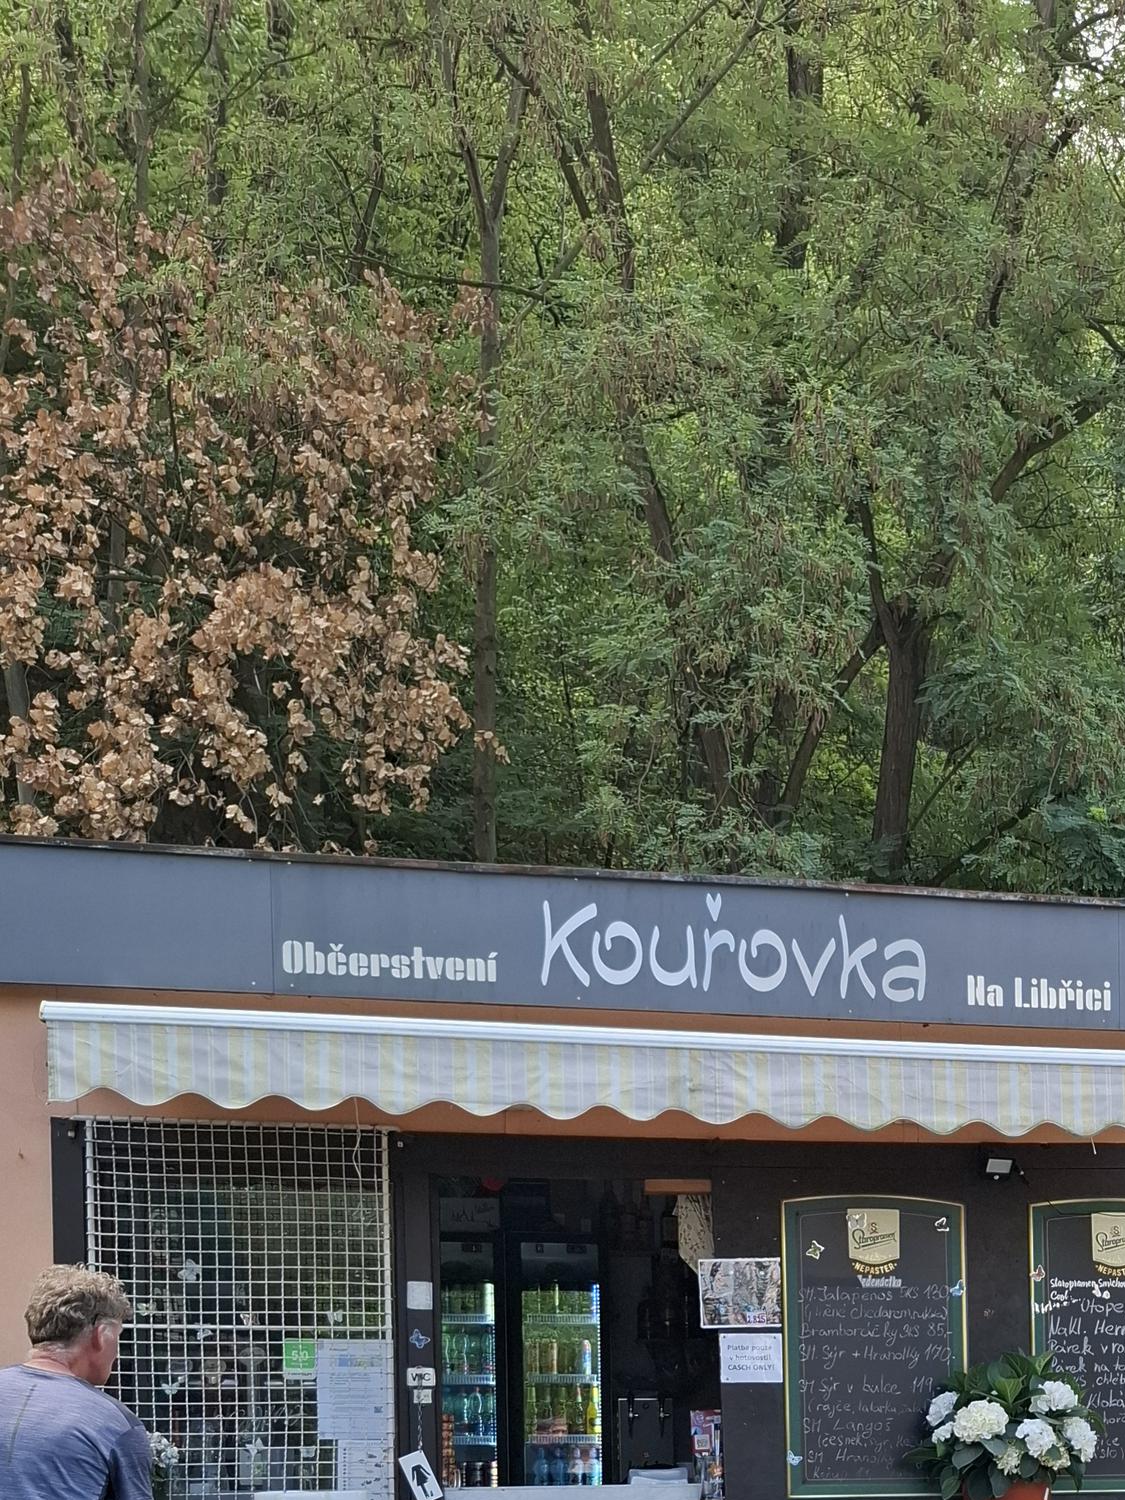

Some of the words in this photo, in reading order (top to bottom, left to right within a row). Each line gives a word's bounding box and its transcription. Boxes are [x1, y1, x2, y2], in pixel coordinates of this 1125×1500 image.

[540, 893, 926, 1001] Kouřovka
[282, 940, 498, 983] Občerstvení
[967, 975, 1003, 1007] Na
[1015, 977, 1111, 1011] Libřici
[851, 1228, 897, 1250] Staropramen
[854, 1262, 896, 1275] NEPASTER
[1048, 1336, 1094, 1355] Párek
[728, 1363, 751, 1371] CASCH
[1094, 1361, 1110, 1373] na
